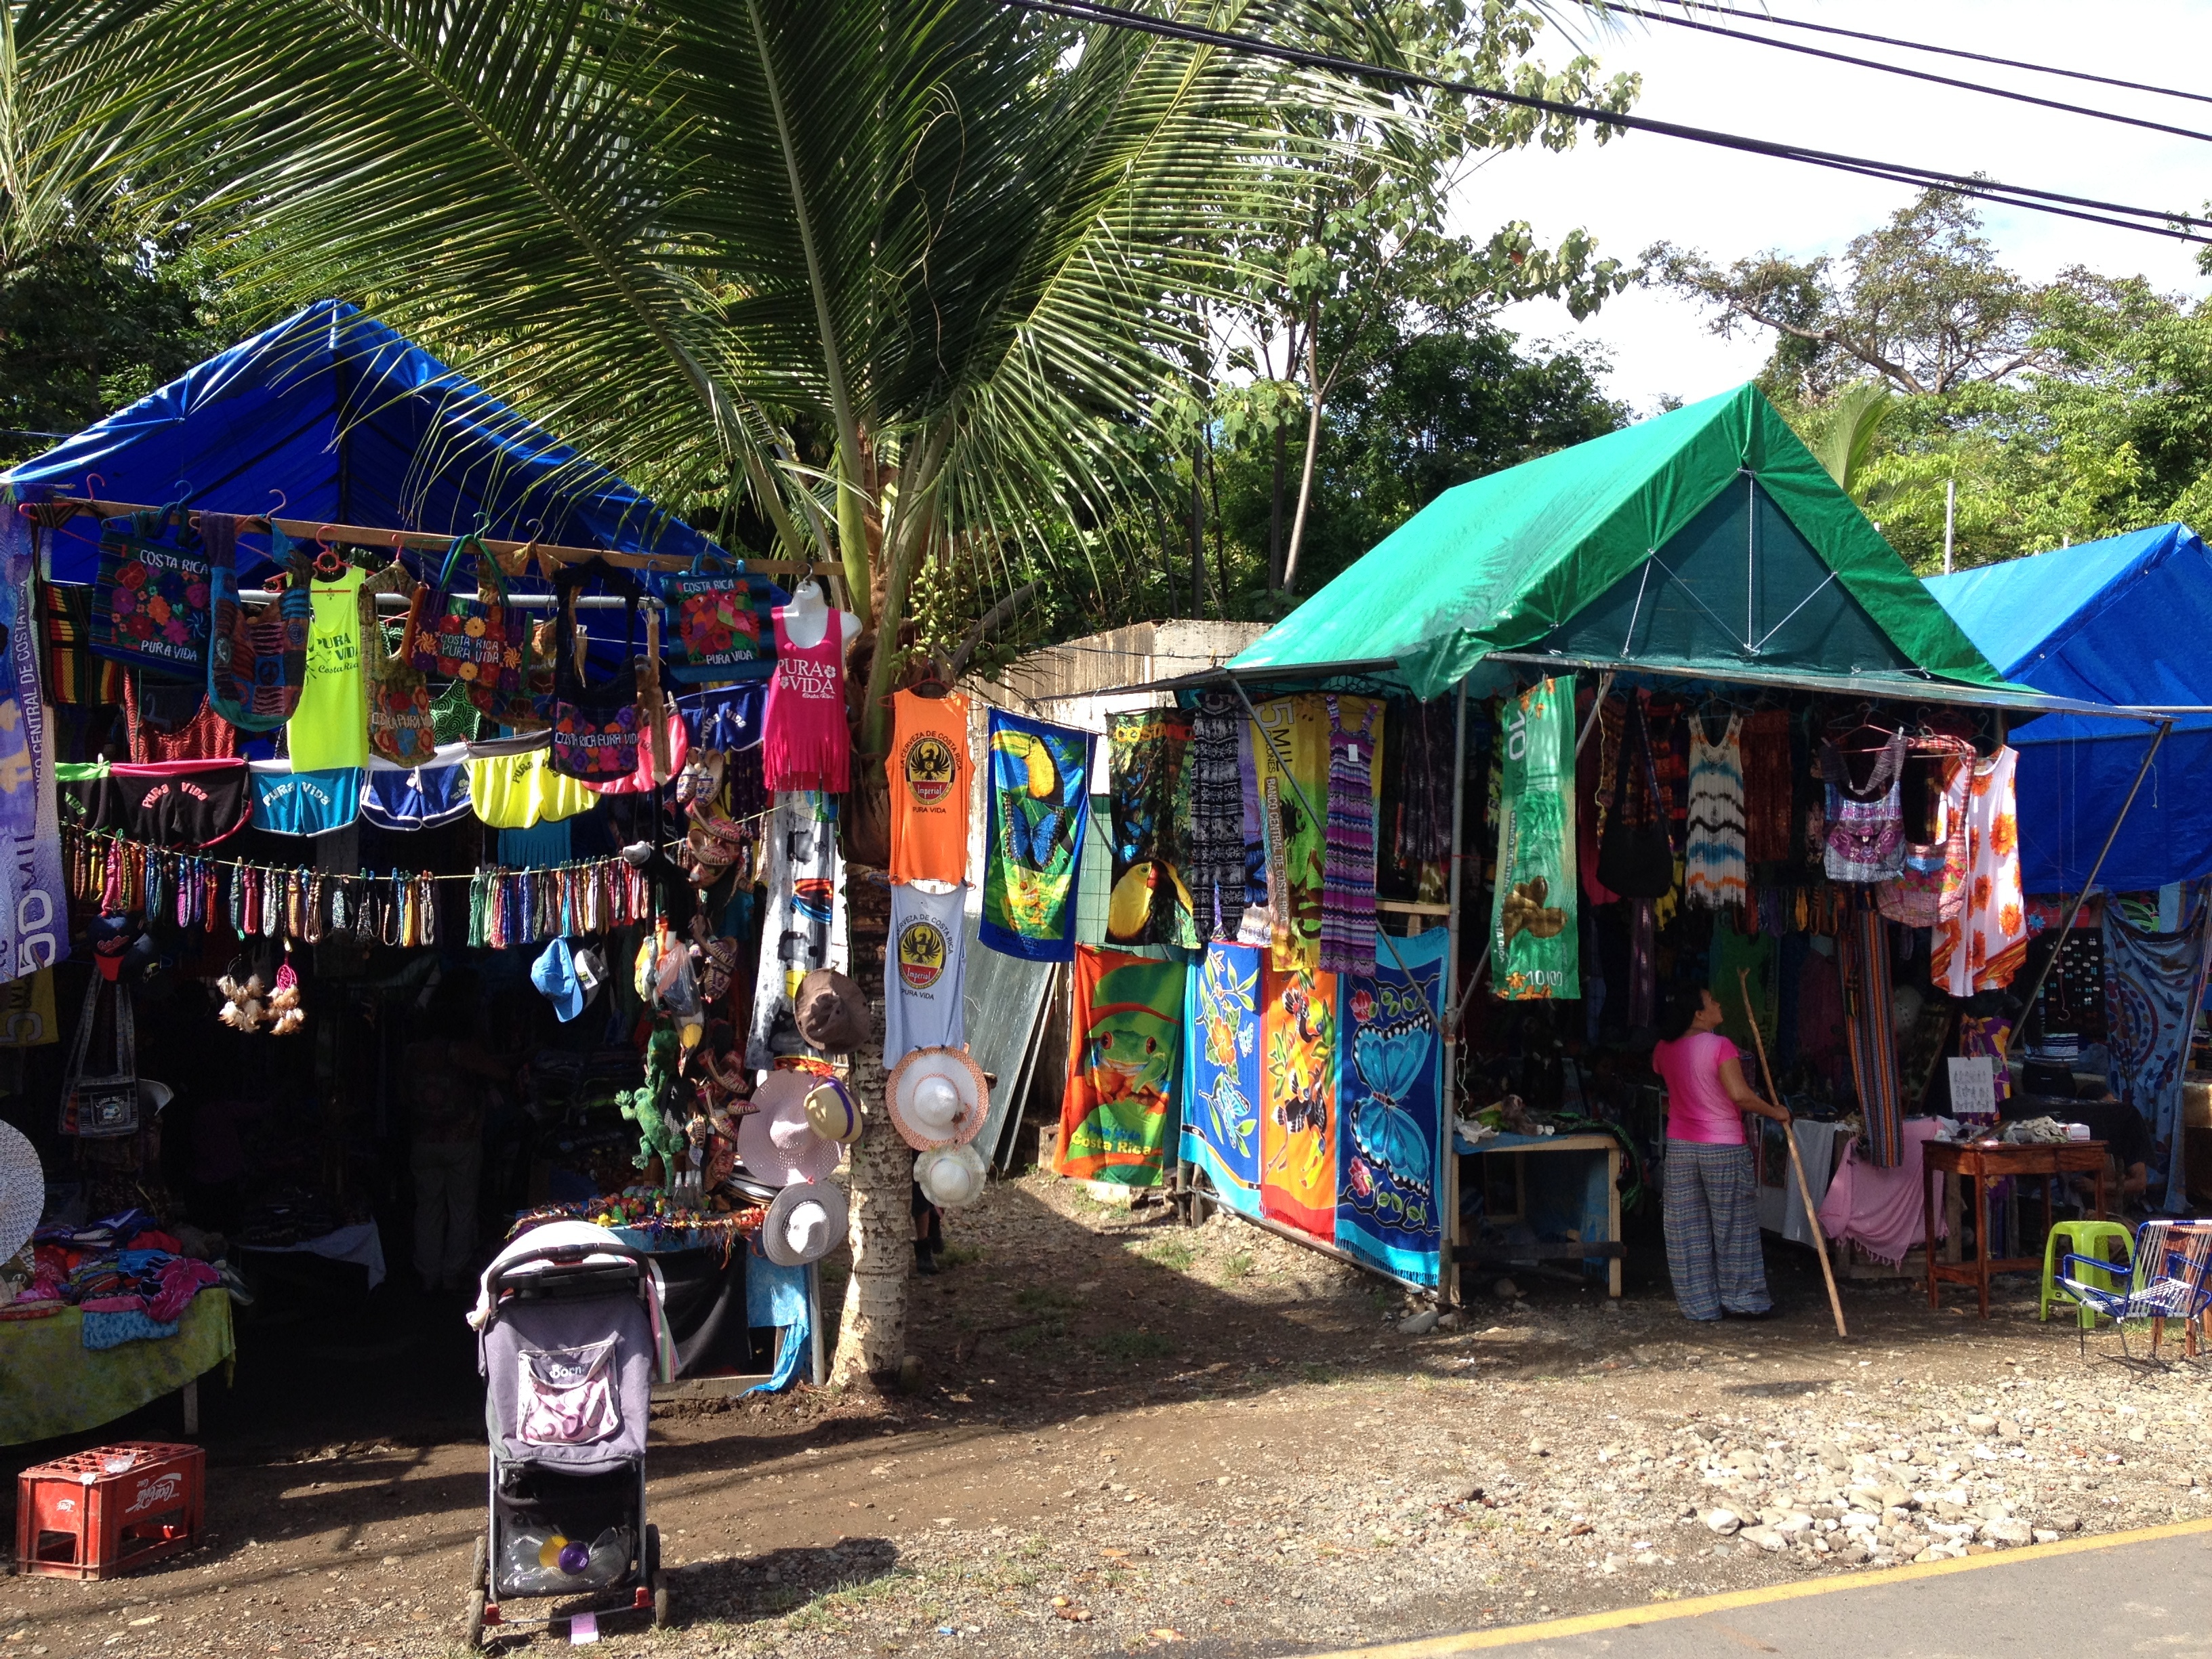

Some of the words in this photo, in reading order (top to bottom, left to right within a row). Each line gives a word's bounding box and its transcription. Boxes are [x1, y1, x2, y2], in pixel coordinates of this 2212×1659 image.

[140, 550, 178, 569] COSTA
[182, 559, 208, 574] RICA
[682, 581, 711, 593] COSTA
[713, 579, 735, 590] RICA
[14, 613, 30, 662] COSTA
[441, 633, 470, 647] COSTA
[475, 638, 499, 651] RICA
[140, 640, 171, 657] PURA
[173, 645, 198, 661] VIDA
[442, 643, 471, 659] PURA
[475, 651, 499, 663] VIDA
[705, 654, 731, 665] PURA
[731, 649, 754, 662] VIDA
[19, 663, 35, 684] DE
[777, 657, 824, 677] PURA
[788, 675, 836, 695] VIDA
[24, 687, 42, 754] CENTRAL
[1115, 722, 1166, 743] COSTA
[1509, 710, 1526, 760] 10
[901, 732, 925, 758] CERVEZA
[938, 733, 958, 755] COSTA
[954, 752, 963, 771] RICA
[918, 784, 942, 799] Imperial
[1266, 778, 1278, 811] BANCO
[1269, 813, 1283, 853] CENTRAL
[1274, 855, 1284, 870] DE
[1276, 870, 1288, 901] COSTA
[1279, 900, 1288, 922] RICA
[18, 888, 57, 979] 50
[897, 914, 918, 933] ERVEZA
[931, 917, 950, 937] COSTA
[907, 967, 931, 982] Imperial
[1071, 1131, 1113, 1151] Costa
[1117, 1141, 1152, 1155] Rica
